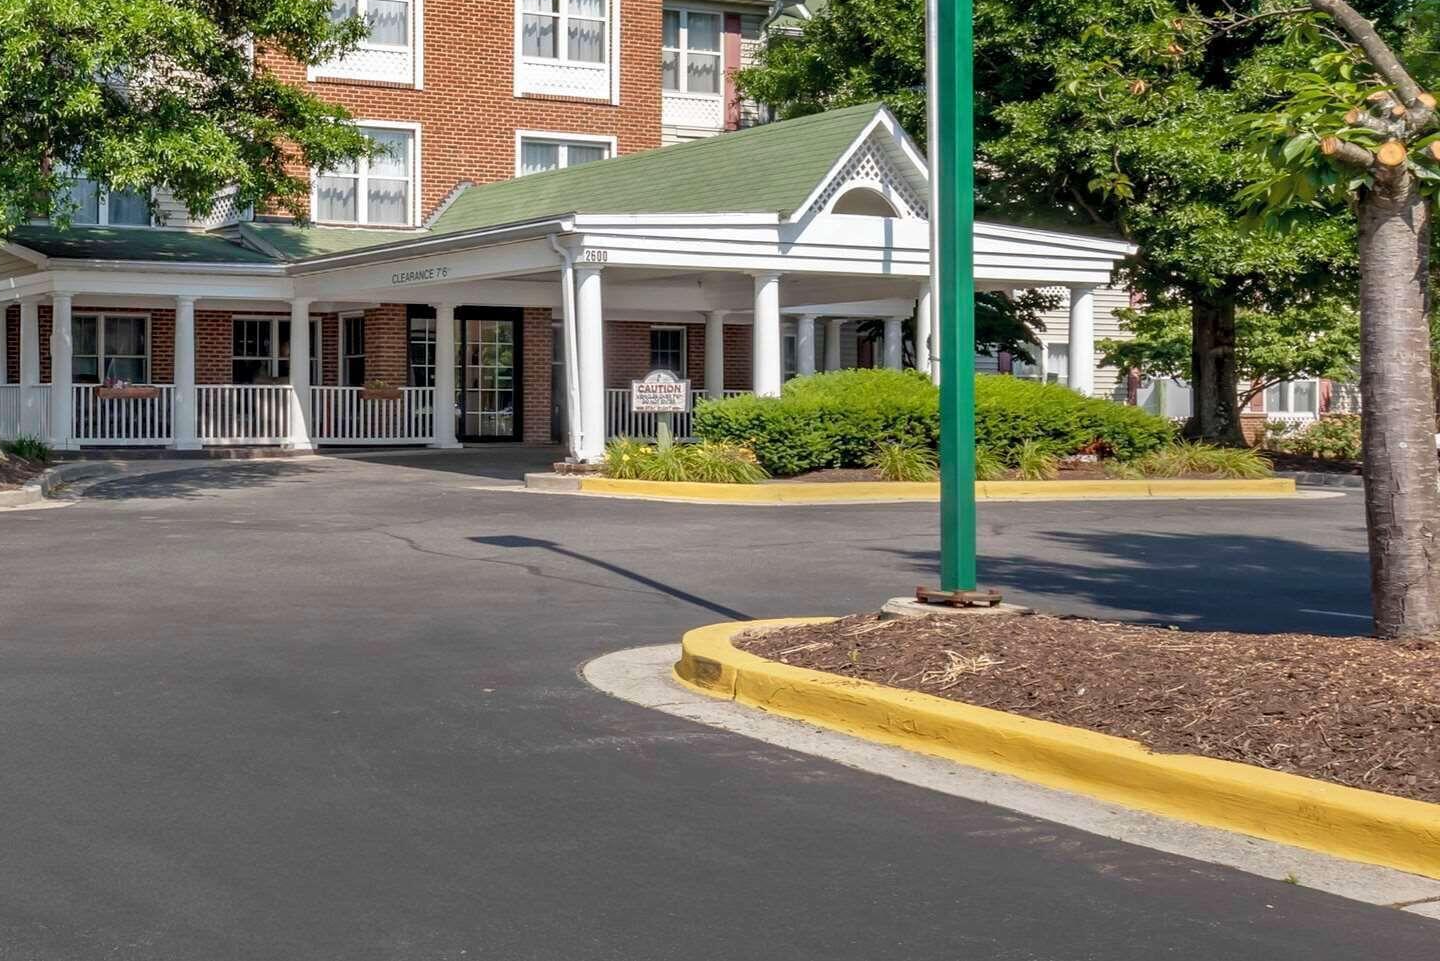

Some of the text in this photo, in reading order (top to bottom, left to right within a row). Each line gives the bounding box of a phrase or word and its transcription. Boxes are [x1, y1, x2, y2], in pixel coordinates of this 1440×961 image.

[585, 249, 608, 262] 2600
[392, 268, 434, 284] CLEARANCE
[638, 384, 681, 393] CAUTION
